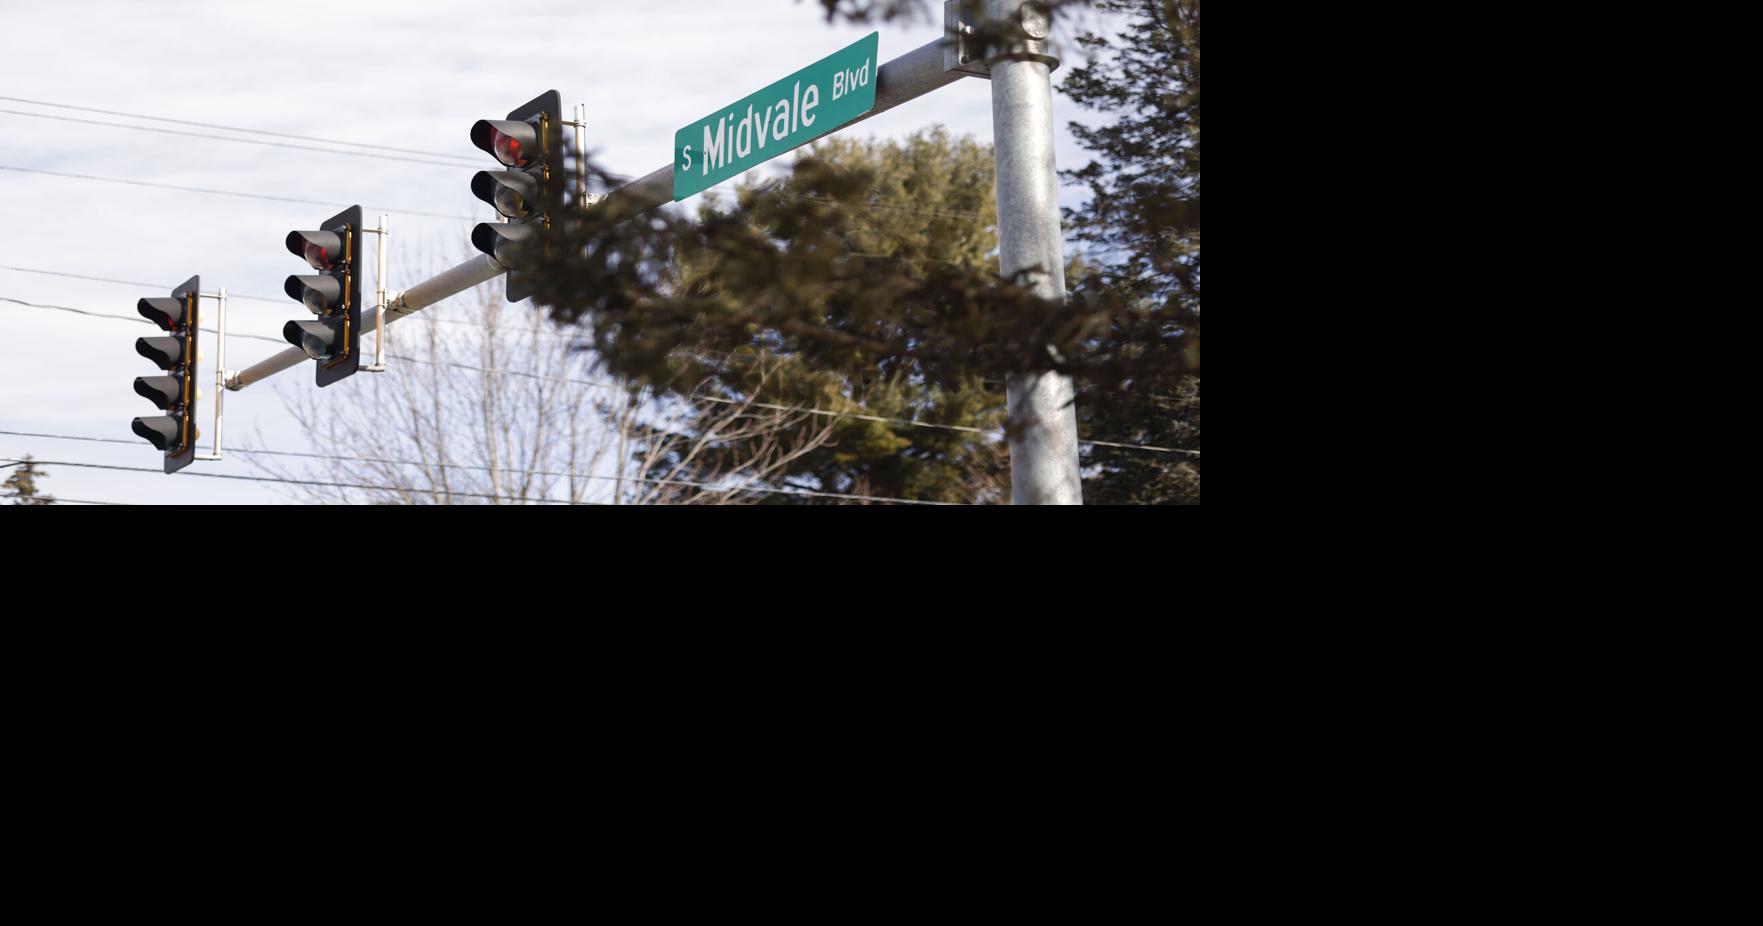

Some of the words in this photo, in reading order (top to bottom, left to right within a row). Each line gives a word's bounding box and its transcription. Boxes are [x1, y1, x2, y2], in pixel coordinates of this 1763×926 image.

[682, 144, 692, 172] S
[702, 80, 820, 177] Midvale
[832, 57, 870, 101] Blvd
